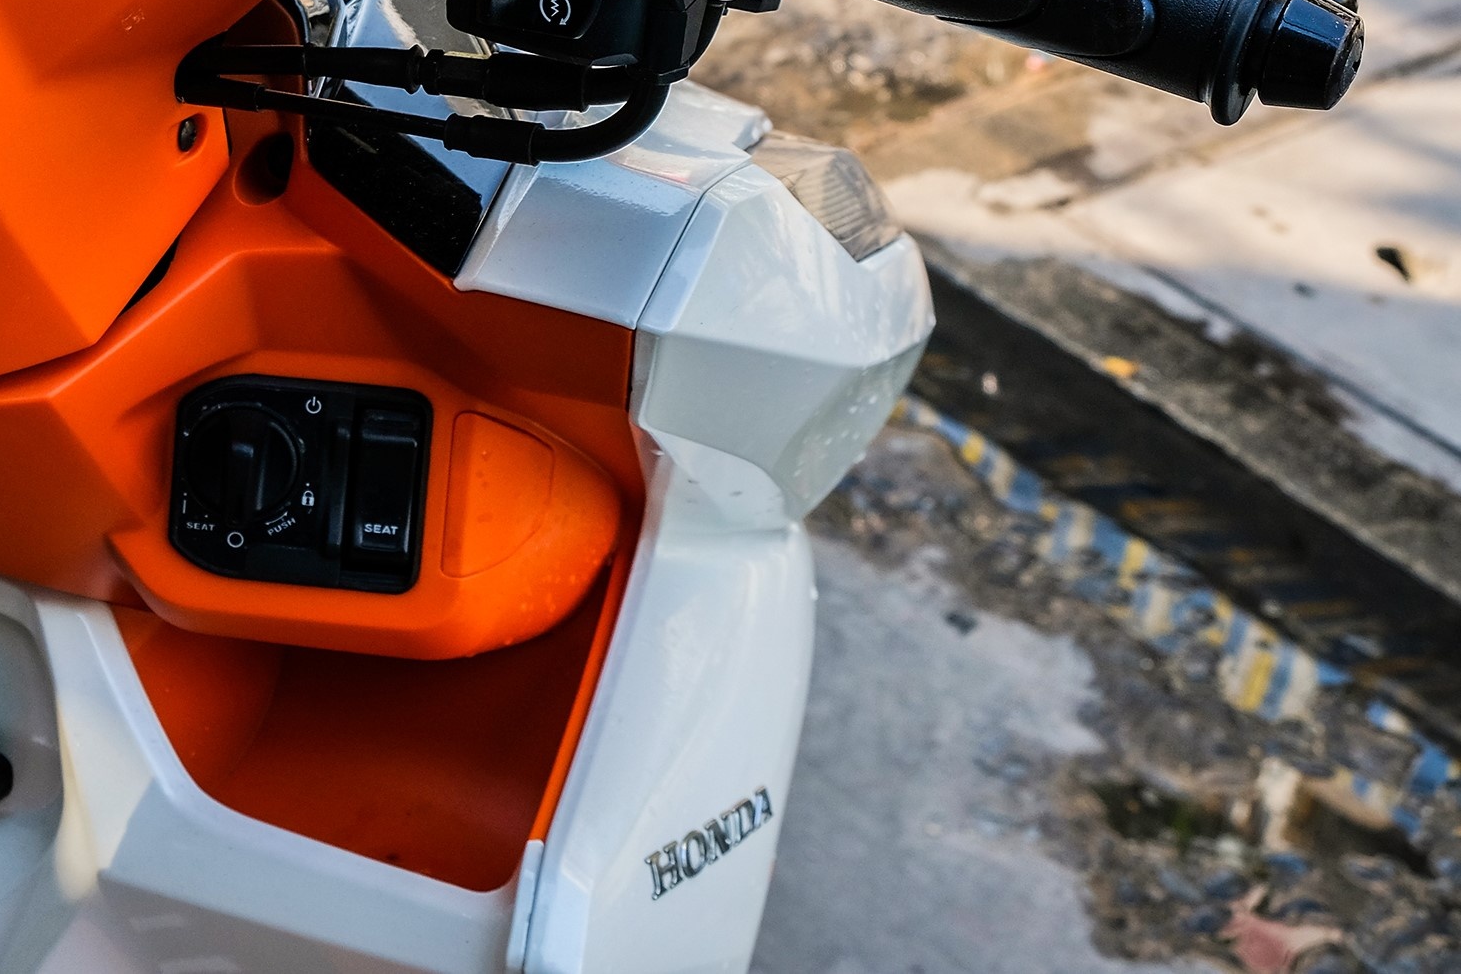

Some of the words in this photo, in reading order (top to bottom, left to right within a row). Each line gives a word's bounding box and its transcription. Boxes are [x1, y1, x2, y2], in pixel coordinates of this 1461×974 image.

[186, 521, 216, 532] SEAT
[267, 517, 296, 537] PUSH
[364, 523, 399, 535] SEAT
[644, 785, 773, 901] HONDA
